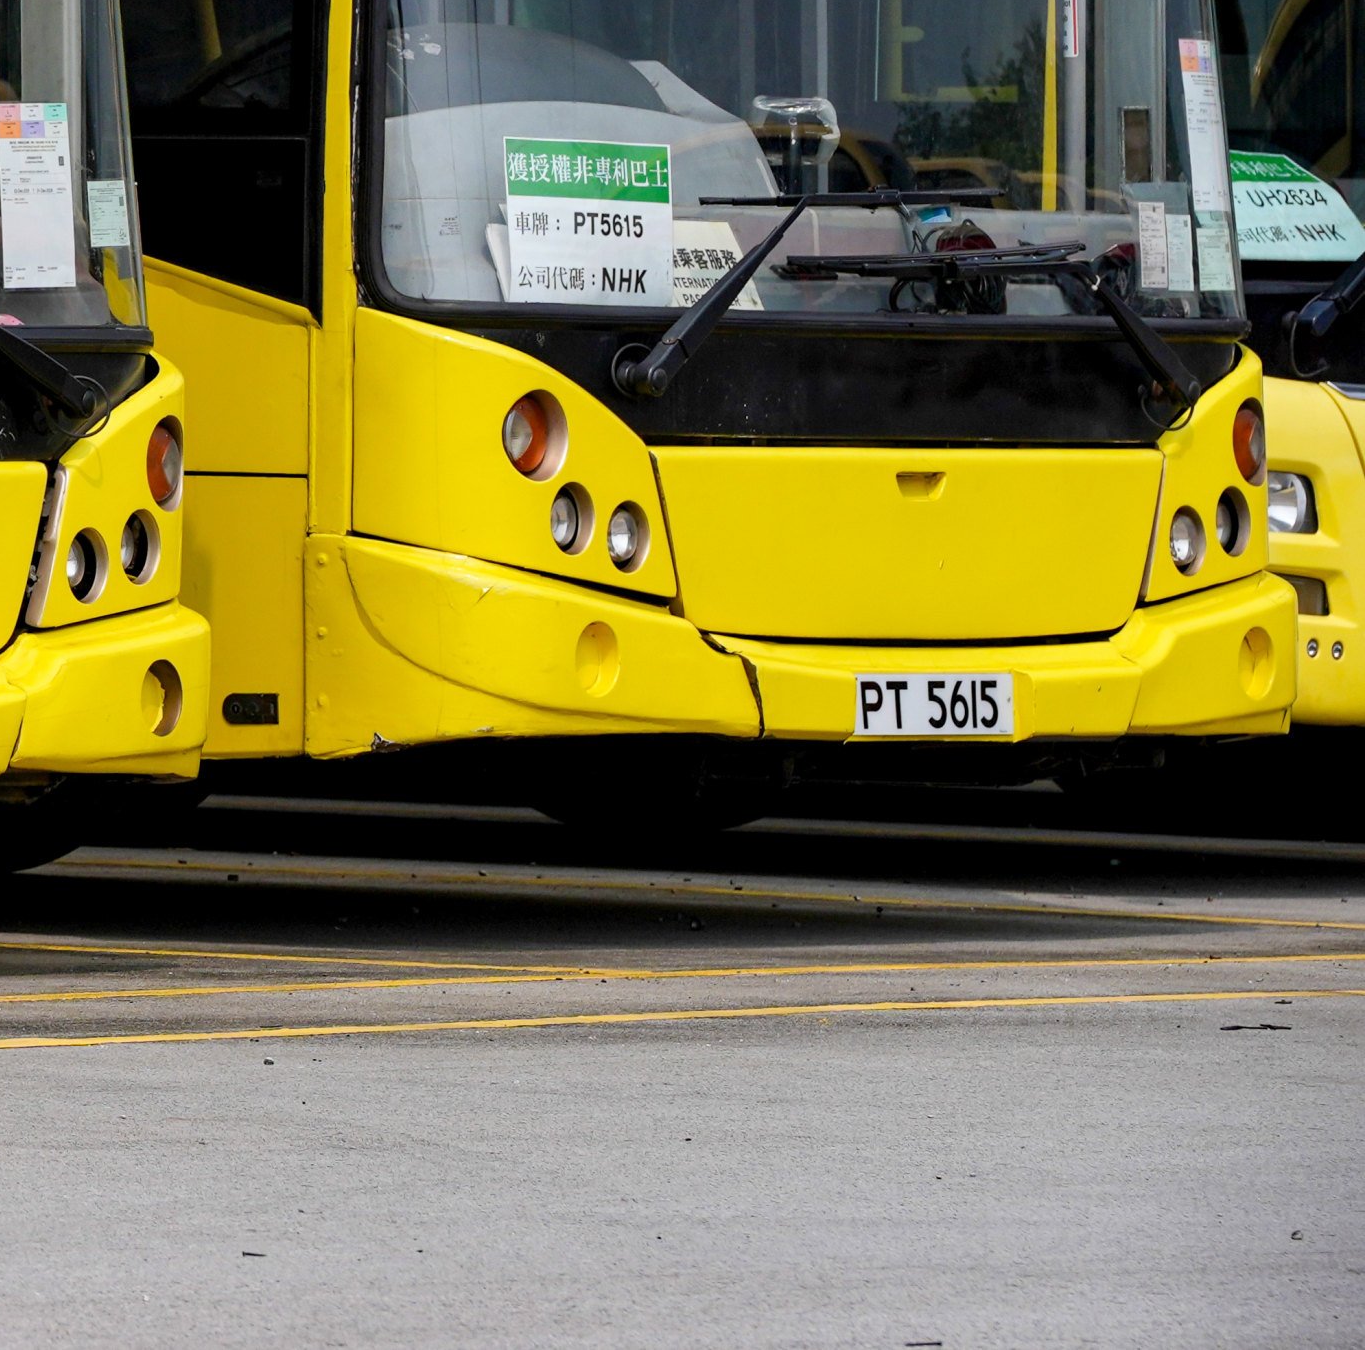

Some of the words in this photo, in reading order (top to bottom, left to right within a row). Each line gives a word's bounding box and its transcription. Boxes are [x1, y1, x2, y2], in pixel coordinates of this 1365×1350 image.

[507, 151, 668, 189] 獲授權非專利巴士
[573, 211, 644, 238] PT5615
[860, 681, 908, 730] PT
[927, 680, 999, 730] 5615
